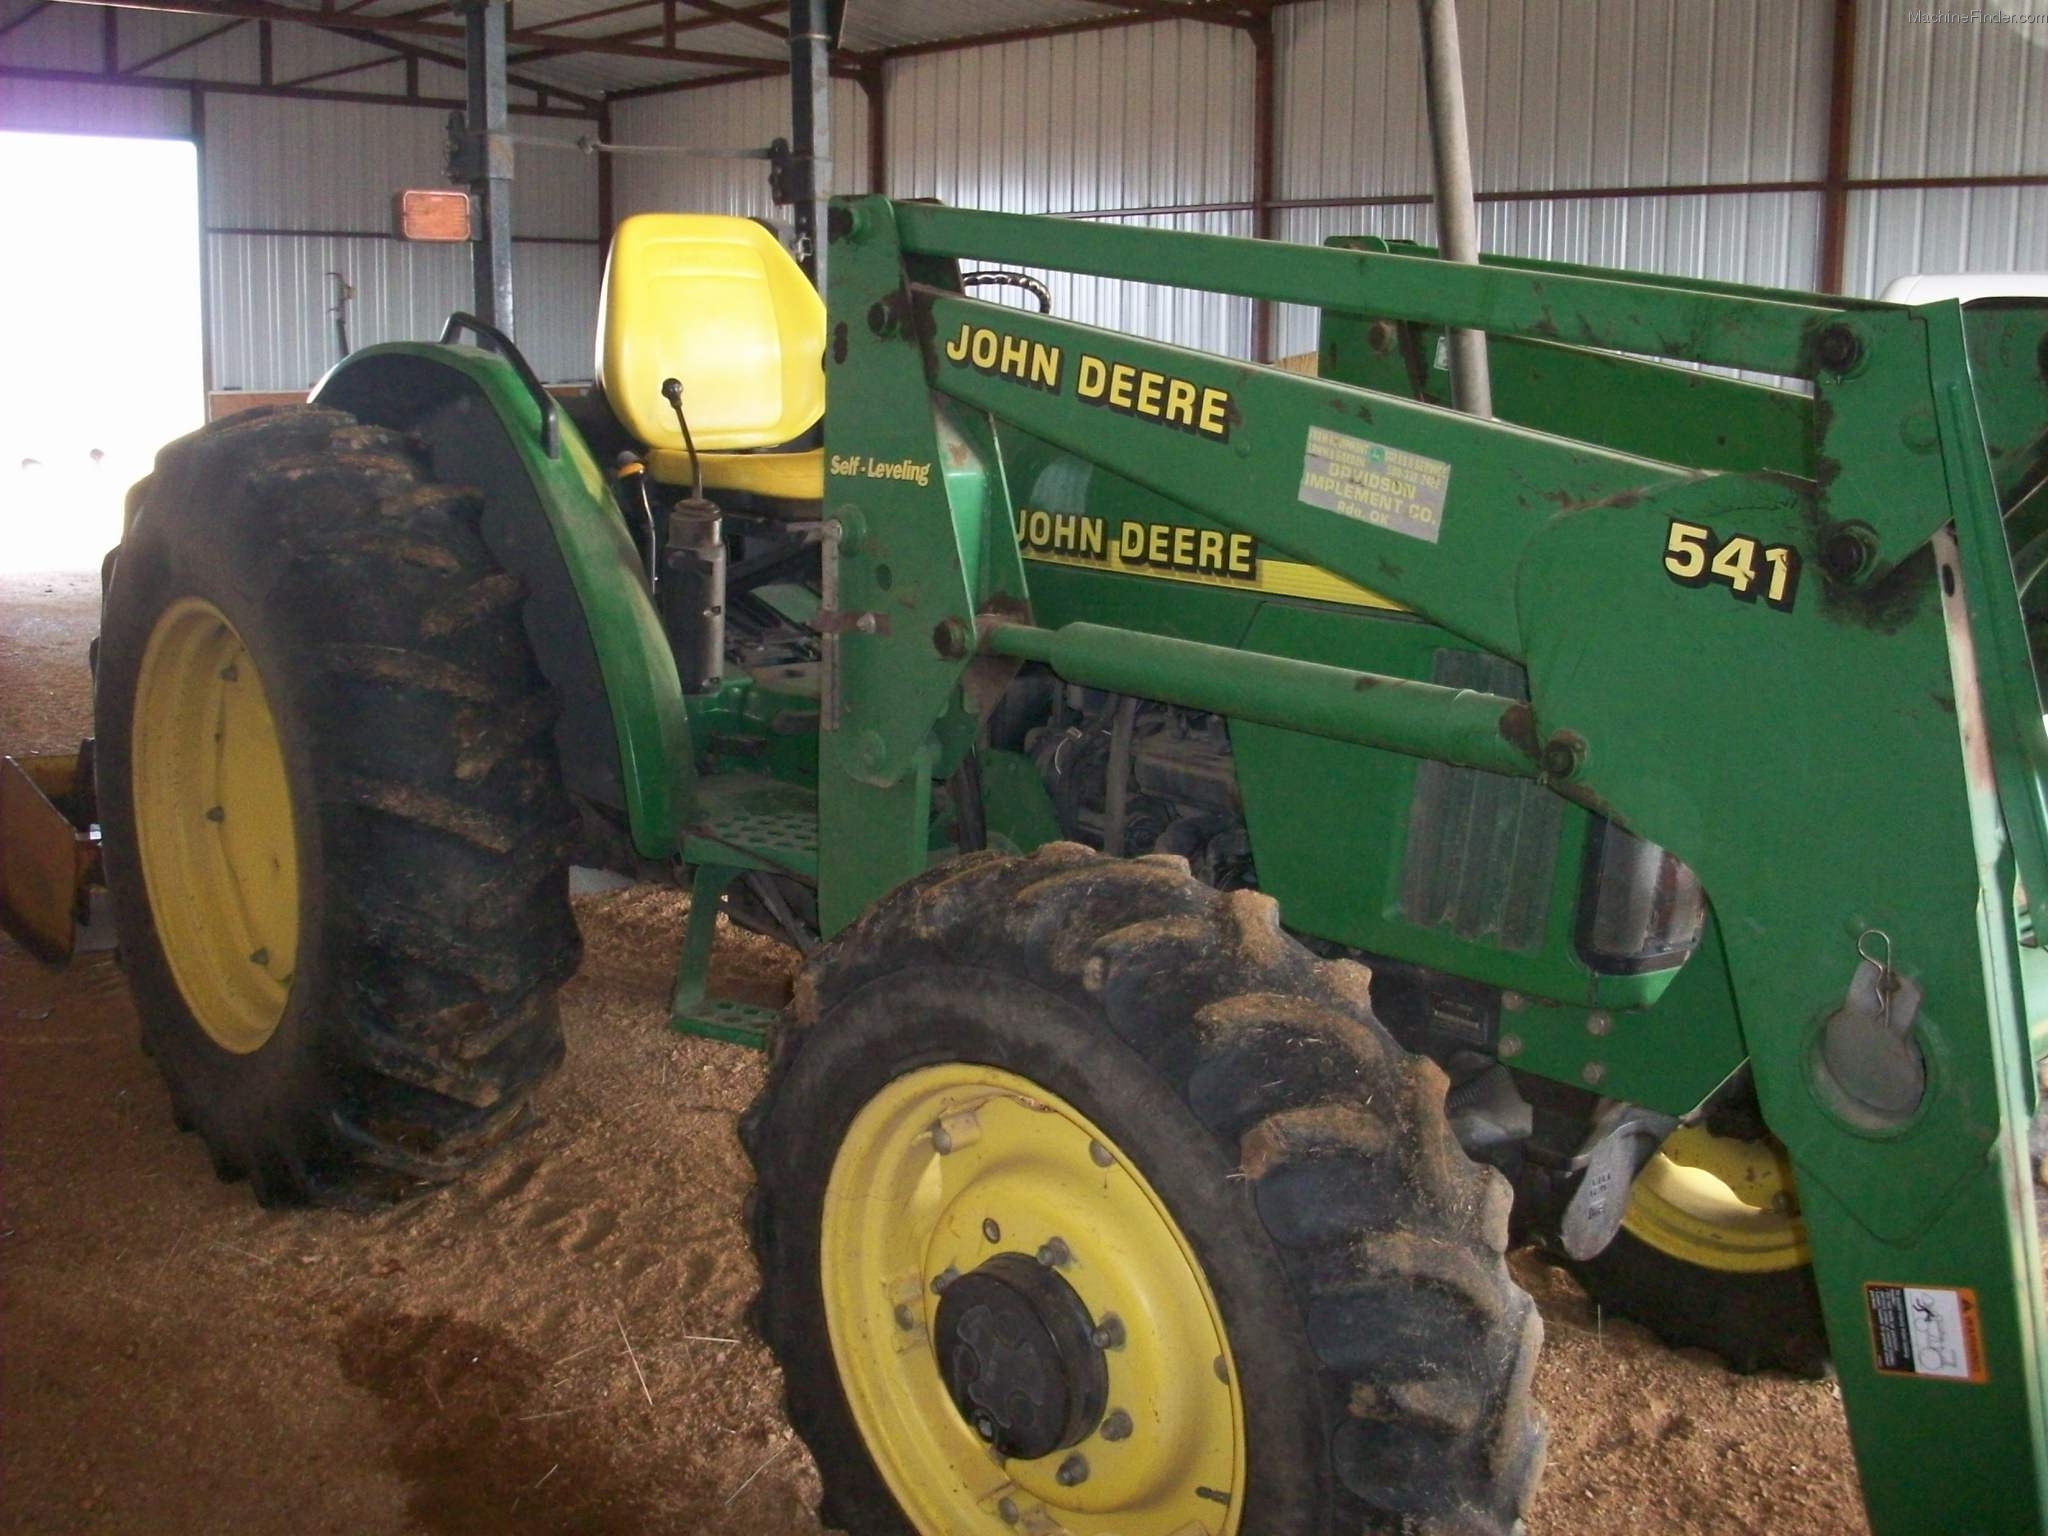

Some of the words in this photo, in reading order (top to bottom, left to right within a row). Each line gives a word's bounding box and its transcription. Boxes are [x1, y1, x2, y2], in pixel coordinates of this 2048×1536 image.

[946, 324, 1061, 390] JOHN
[1077, 354, 1230, 438] DEERE
[1303, 471, 1403, 514] IMPLEMENT
[1016, 509, 1105, 557] JOHN
[1120, 520, 1254, 577] DEERE
[1664, 520, 1795, 608] 541
